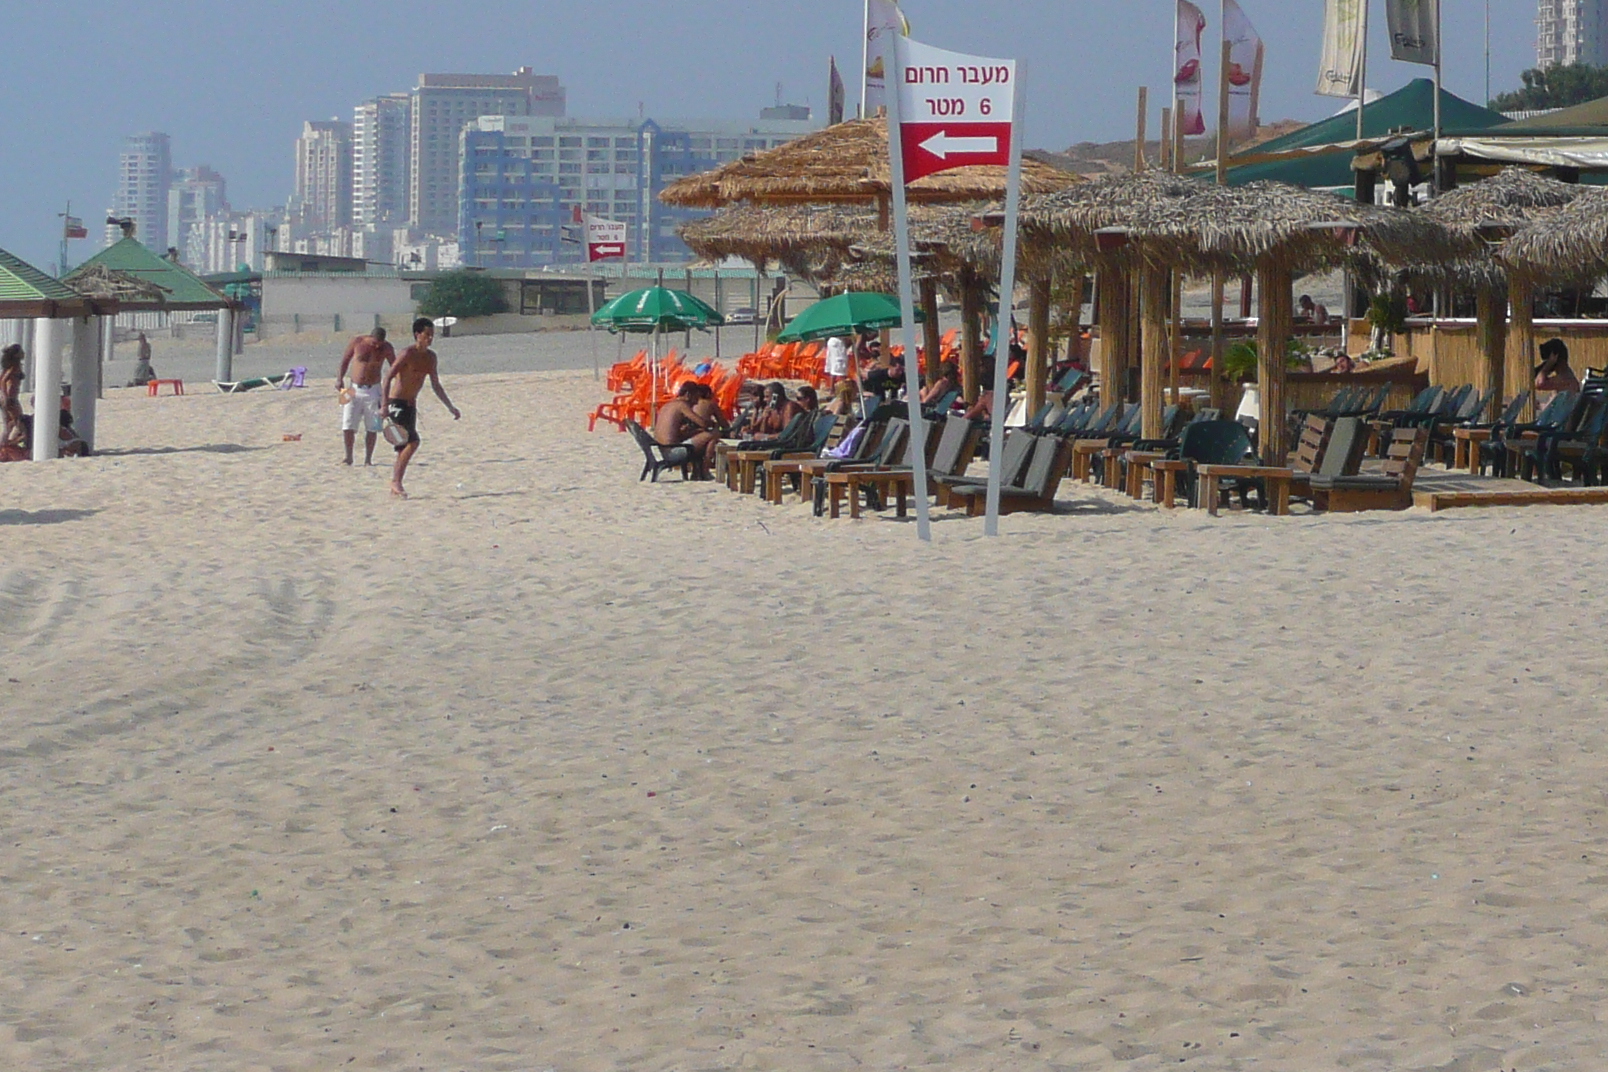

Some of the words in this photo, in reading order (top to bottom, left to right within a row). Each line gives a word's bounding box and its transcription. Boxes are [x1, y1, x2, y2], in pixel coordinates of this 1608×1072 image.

[905, 66, 949, 83] חרום
[957, 66, 1009, 85] מעבר
[925, 98, 964, 115] מטר
[980, 98, 991, 115] 6
